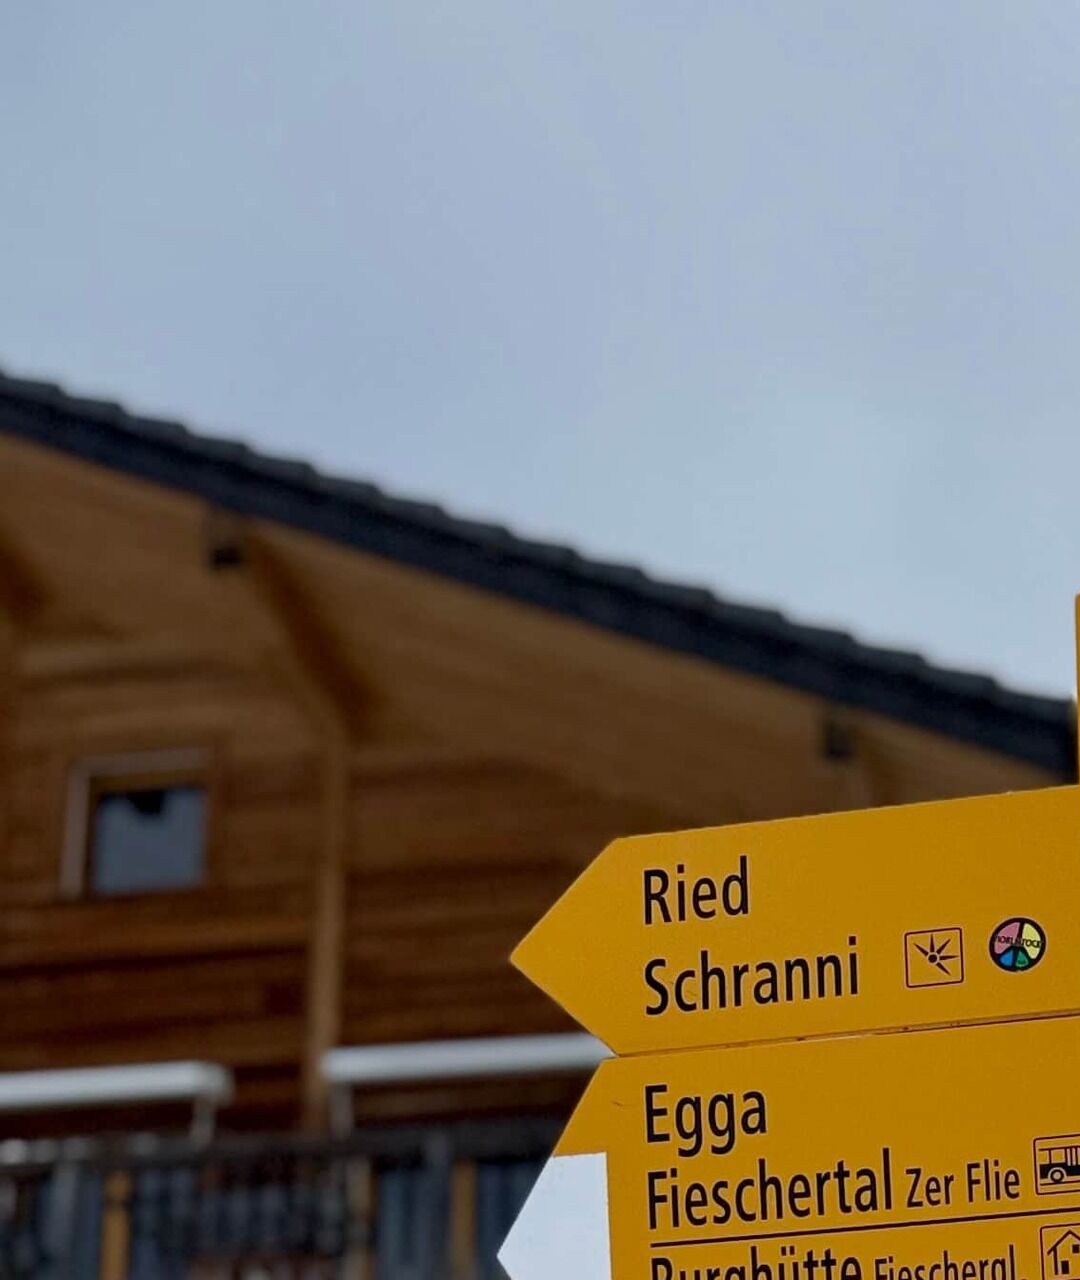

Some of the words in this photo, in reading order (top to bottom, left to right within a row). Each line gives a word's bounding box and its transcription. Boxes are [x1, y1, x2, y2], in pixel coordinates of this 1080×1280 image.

[642, 854, 751, 925] Ried
[643, 937, 860, 1016] Schranni
[644, 1084, 768, 1158] Egga
[647, 1147, 893, 1231] Fieschertal
[905, 1168, 955, 1208] Zer
[966, 1159, 1021, 1203] Flie
